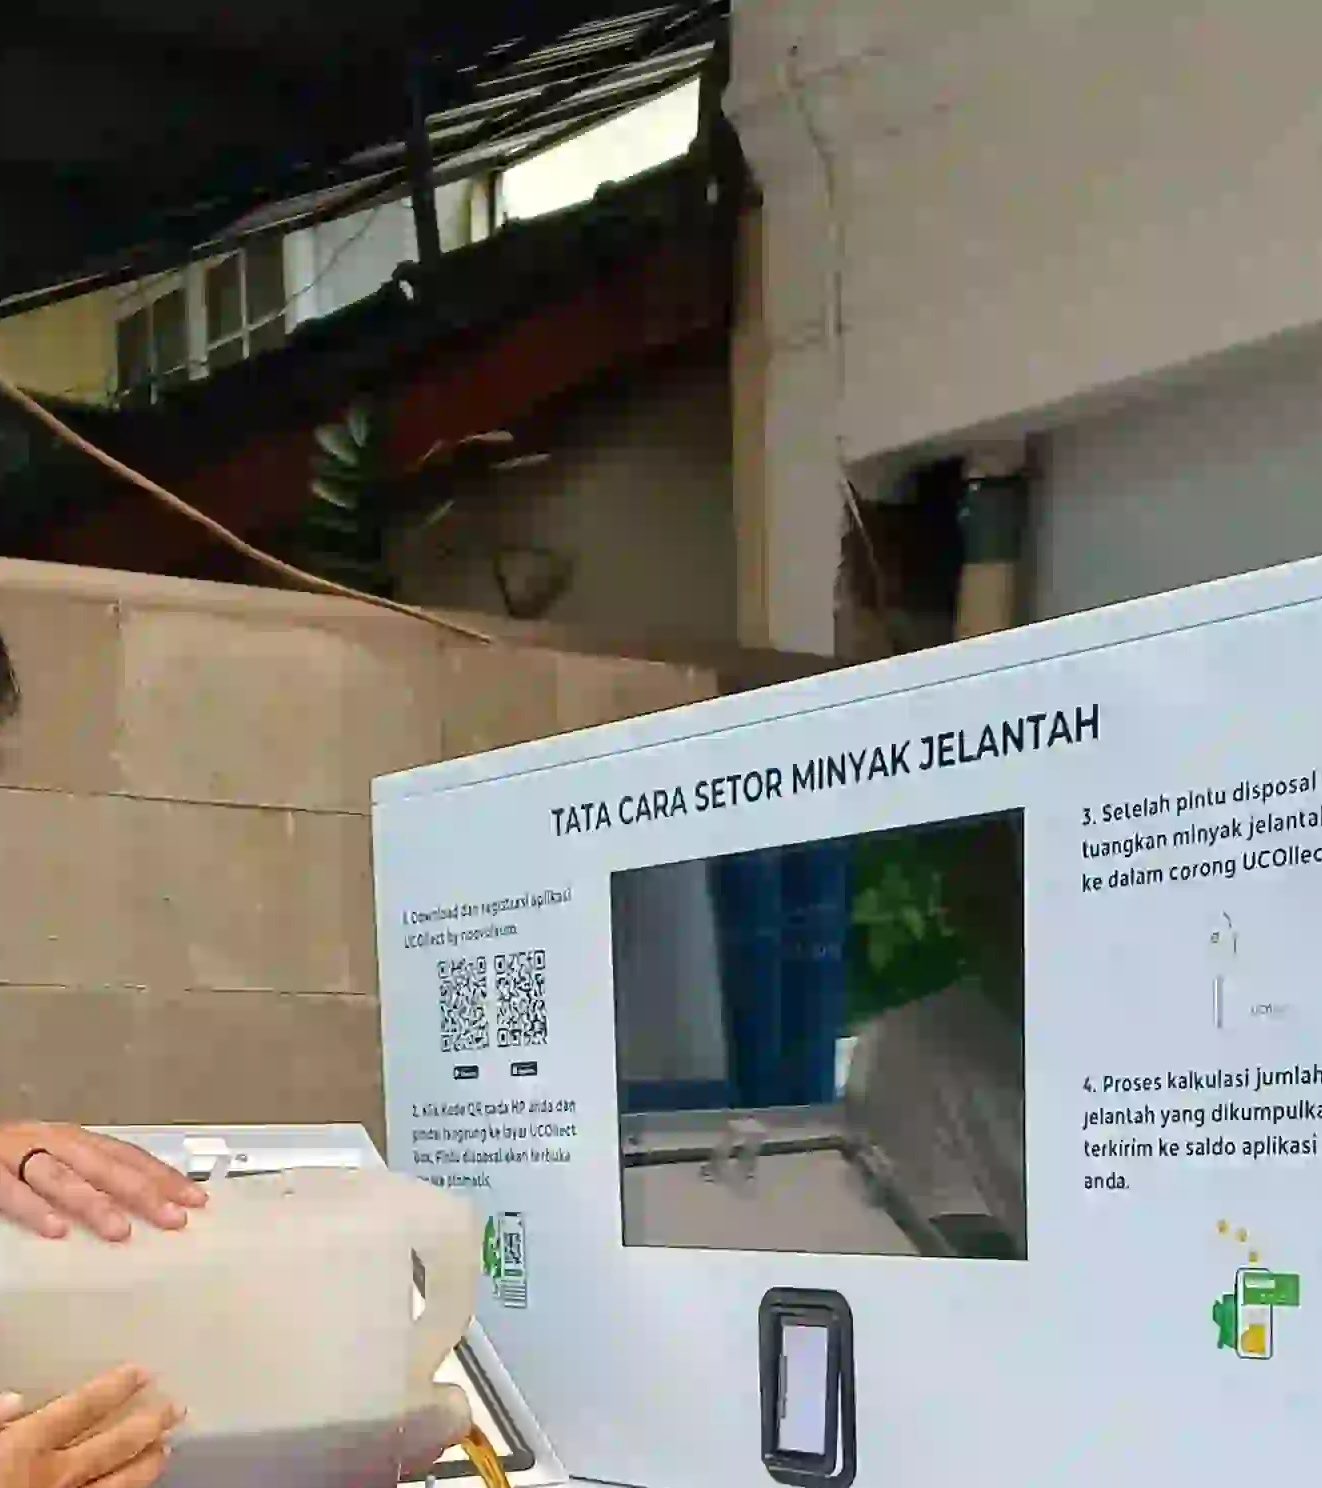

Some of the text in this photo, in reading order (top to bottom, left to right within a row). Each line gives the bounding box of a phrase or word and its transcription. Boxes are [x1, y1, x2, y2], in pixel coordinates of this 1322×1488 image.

[551, 702, 1100, 837] TATA CARA SETOR MINYAK JELANTAH
[1082, 808, 1097, 825] 3.
[1102, 793, 1170, 824] Setelah
[1177, 788, 1227, 816] pintu
[1232, 769, 1317, 805] disposal
[1082, 832, 1167, 861] tuangkan
[1172, 818, 1243, 848] minyak
[1082, 873, 1103, 893] ke
[1108, 863, 1163, 889] dalam
[1169, 854, 1236, 881] corong
[1082, 1074, 1097, 1093] 4.
[1103, 1074, 1162, 1093] Proses
[1167, 1067, 1250, 1091] kalkulasi
[1082, 1103, 1156, 1131] jelantah
[1160, 1107, 1205, 1129] yang
[1083, 1137, 1153, 1158] terkirim
[1158, 1138, 1178, 1157] ke
[1186, 1135, 1236, 1157] saldo
[1242, 1132, 1318, 1160] aplikasi
[1083, 1170, 1130, 1190] anda.
